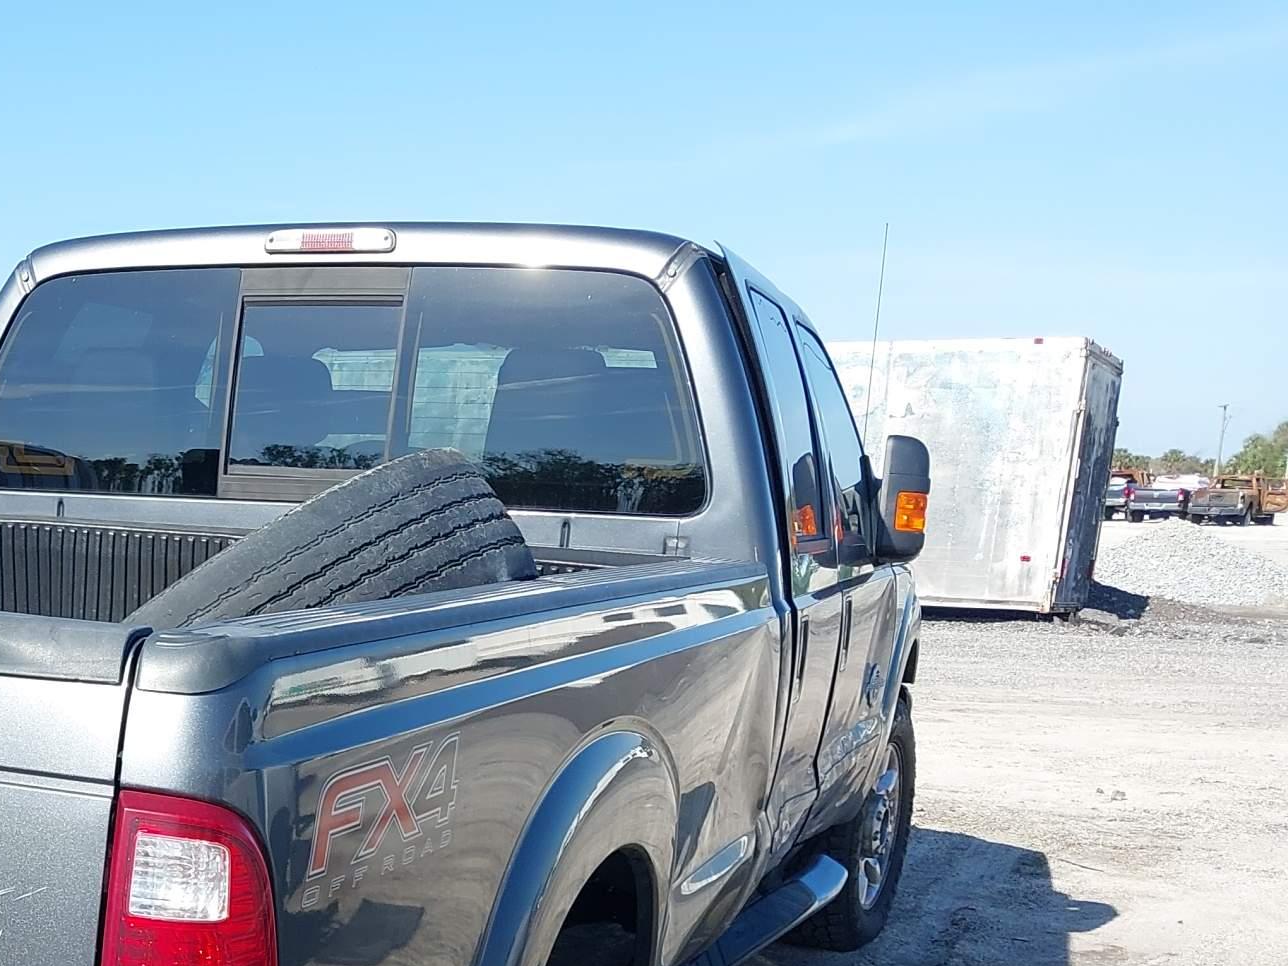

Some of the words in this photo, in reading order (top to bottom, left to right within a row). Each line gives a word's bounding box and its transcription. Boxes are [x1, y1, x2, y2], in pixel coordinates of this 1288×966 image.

[306, 731, 460, 882] FX4
[301, 865, 368, 909] OFF
[381, 829, 453, 876] ROAD
